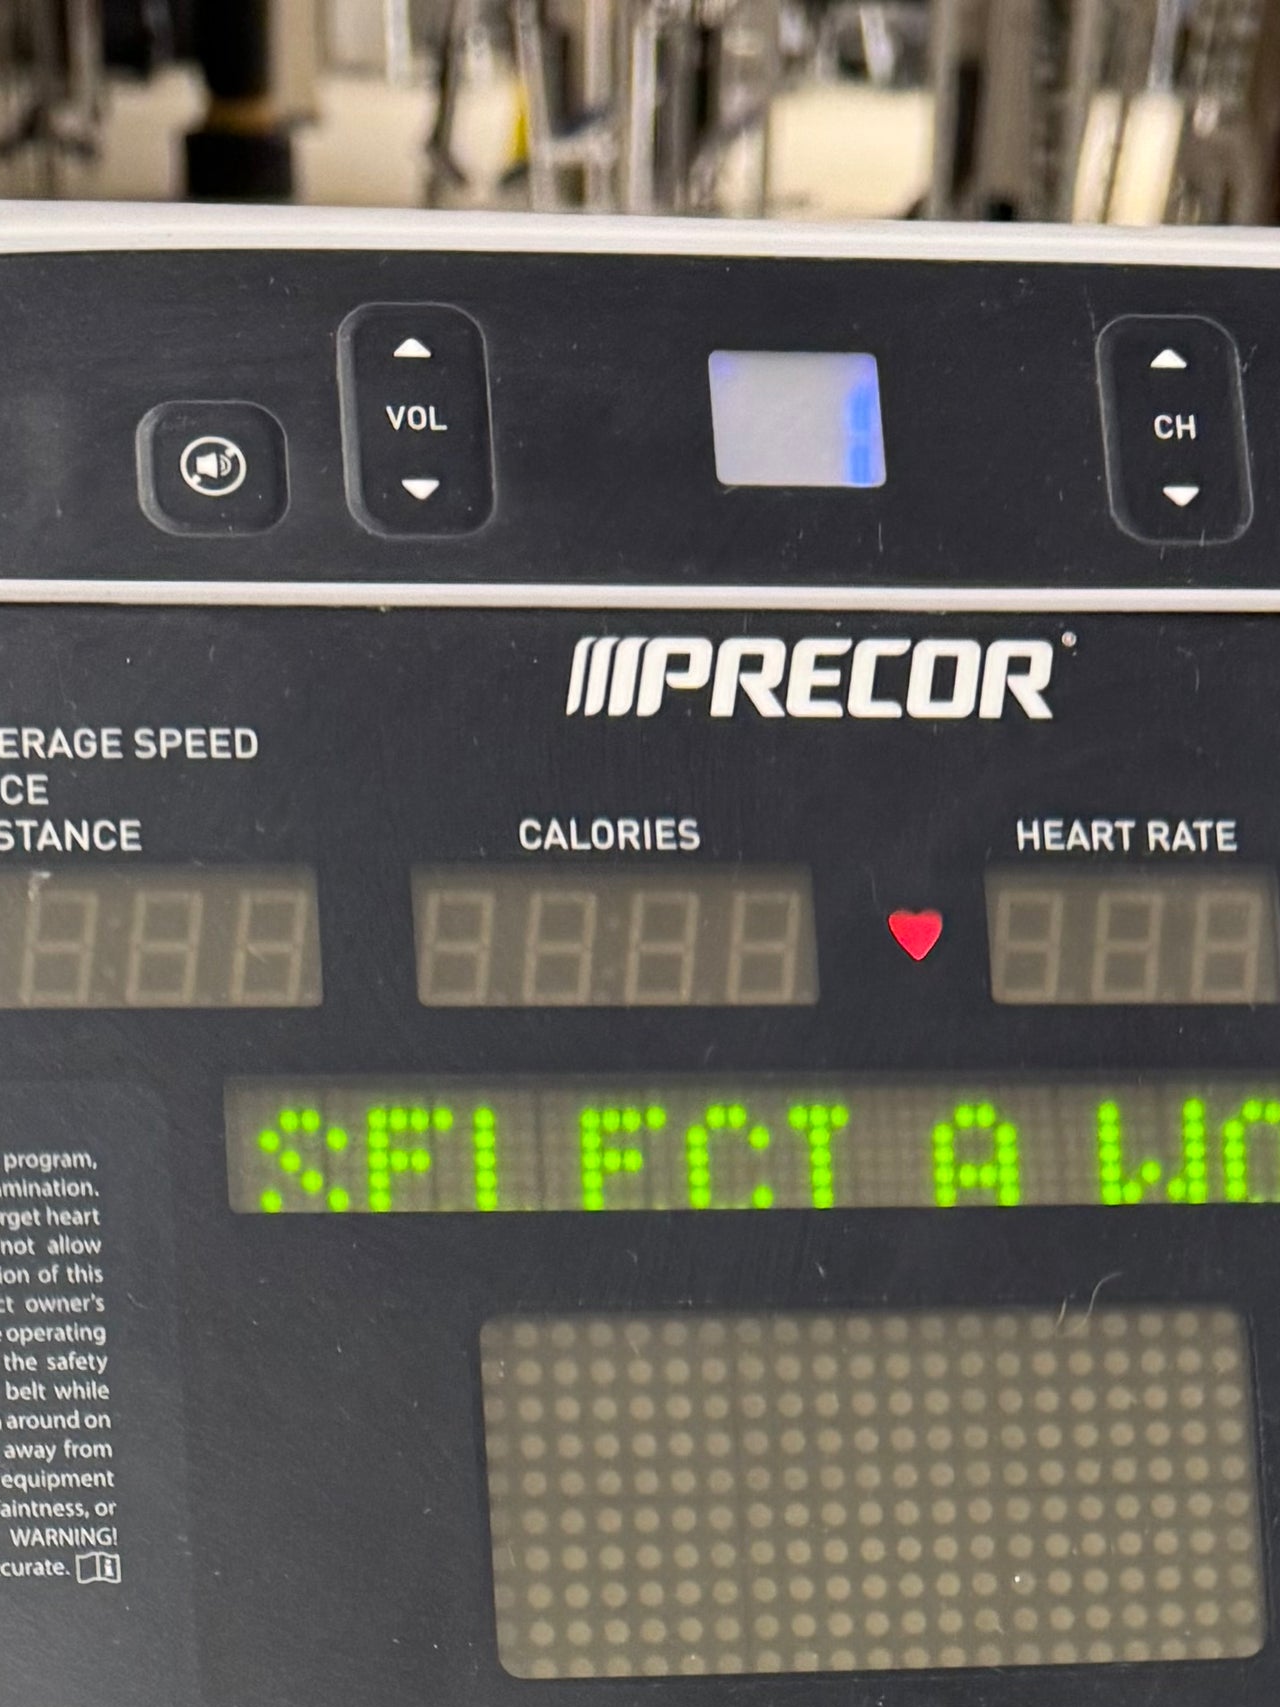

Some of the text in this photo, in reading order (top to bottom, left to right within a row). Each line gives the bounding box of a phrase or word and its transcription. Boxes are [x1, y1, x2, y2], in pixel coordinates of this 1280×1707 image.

[385, 405, 448, 431] VOL
[1154, 414, 1196, 440] CH
[134, 727, 258, 759] SPEED
[519, 818, 701, 850] CALORIES
[1016, 820, 1238, 852] HEART RATE
[3, 1154, 97, 1173] program,
[932, 1100, 1022, 1208] A
[0, 1239, 35, 1255] not
[46, 1236, 103, 1254] allow
[37, 1265, 60, 1284] of
[66, 1265, 104, 1283] this
[25, 1294, 105, 1313] owner's
[5, 1323, 107, 1346] operating
[3, 1353, 38, 1371] the
[46, 1352, 109, 1375] safety
[5, 1382, 47, 1401] belt
[54, 1381, 110, 1400] while
[3, 1444, 58, 1463] away
[63, 1440, 113, 1458] from
[0, 1469, 115, 1493] equipment
[95, 1502, 118, 1516] or
[10, 1529, 119, 1547] WARNING!
